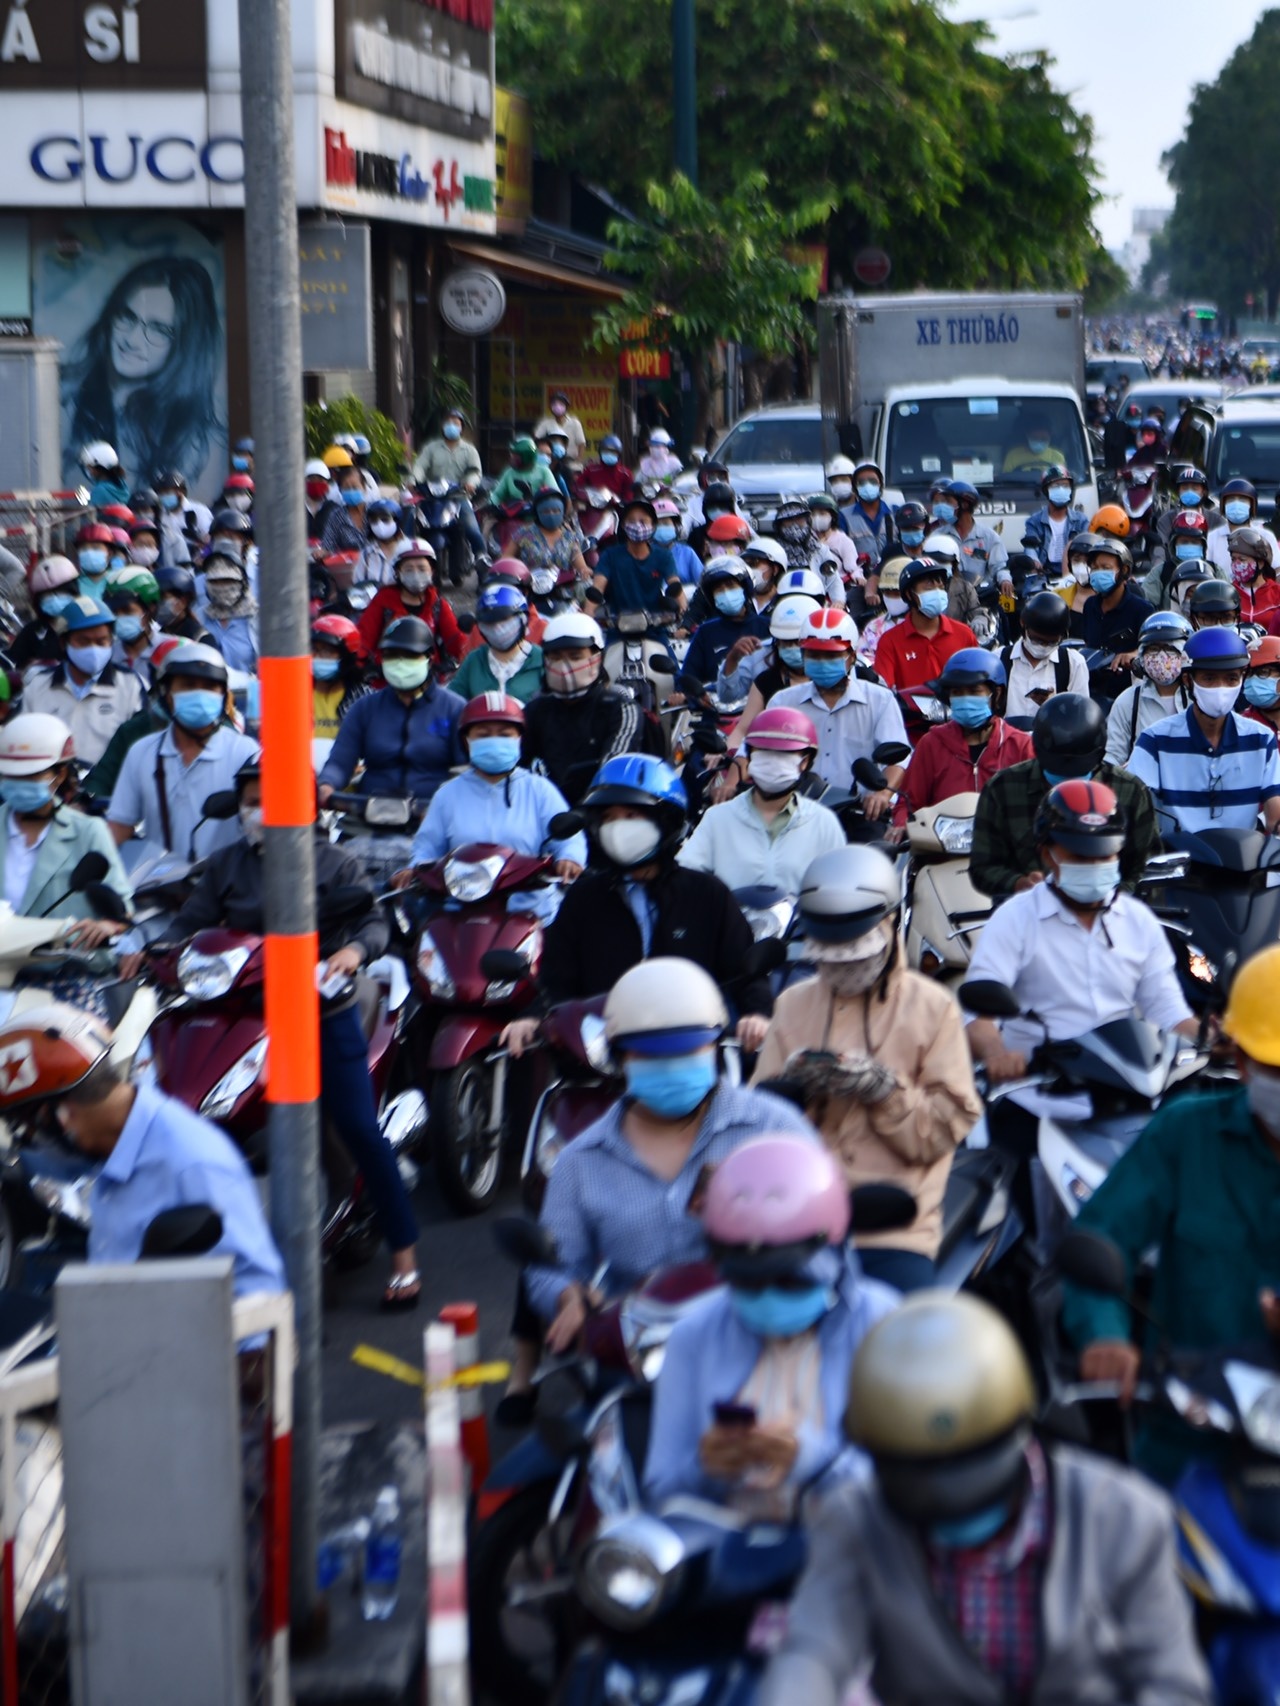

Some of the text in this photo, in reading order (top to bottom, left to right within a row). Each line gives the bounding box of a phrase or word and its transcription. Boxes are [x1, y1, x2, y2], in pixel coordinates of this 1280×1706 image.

[29, 134, 245, 185] GUCC
[916, 318, 941, 345] XE
[625, 348, 661, 377] COPY
[974, 501, 1016, 515] SUZU
